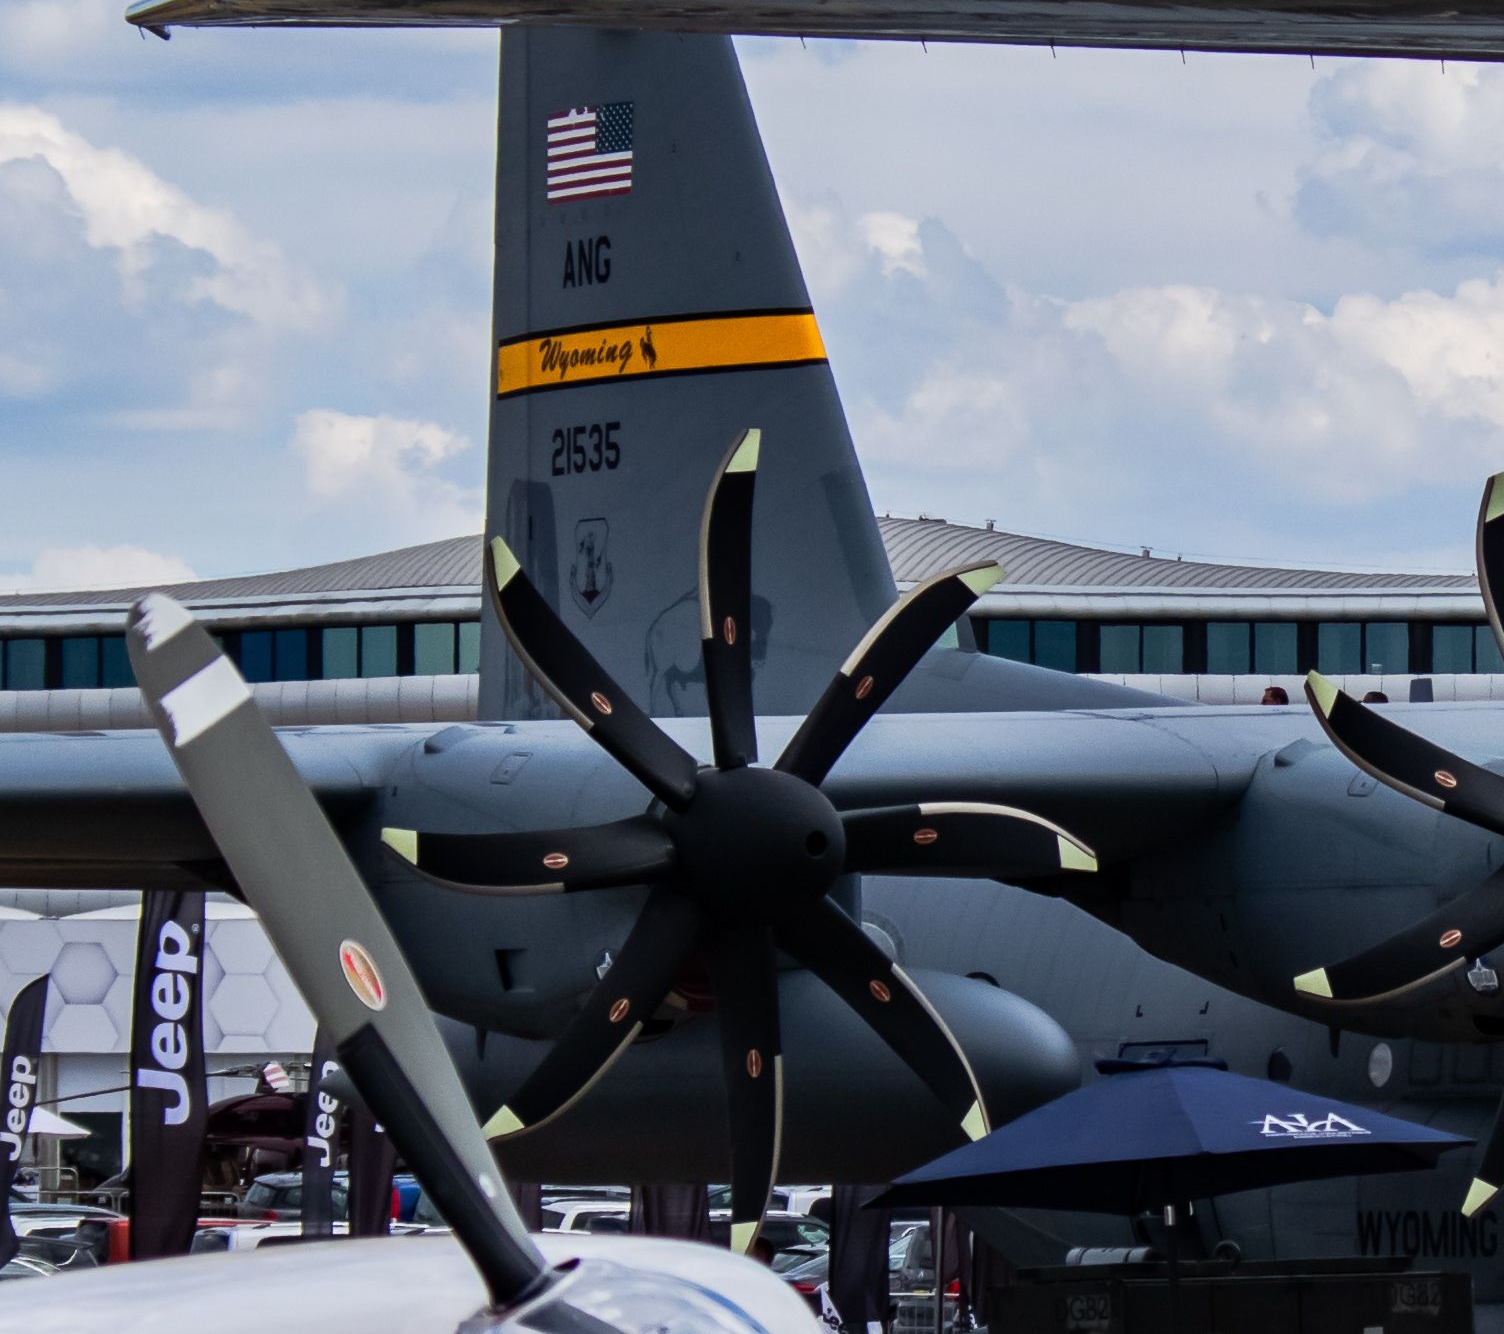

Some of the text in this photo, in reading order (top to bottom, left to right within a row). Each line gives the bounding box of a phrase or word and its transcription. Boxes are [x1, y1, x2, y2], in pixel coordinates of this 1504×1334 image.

[562, 236, 612, 289] ANG
[539, 337, 634, 382] Wyoming
[551, 420, 622, 476] 21535
[137, 920, 200, 1127] Jeep
[0, 1054, 38, 1162] Jeep
[1356, 1210, 1498, 1259] WYOMING
